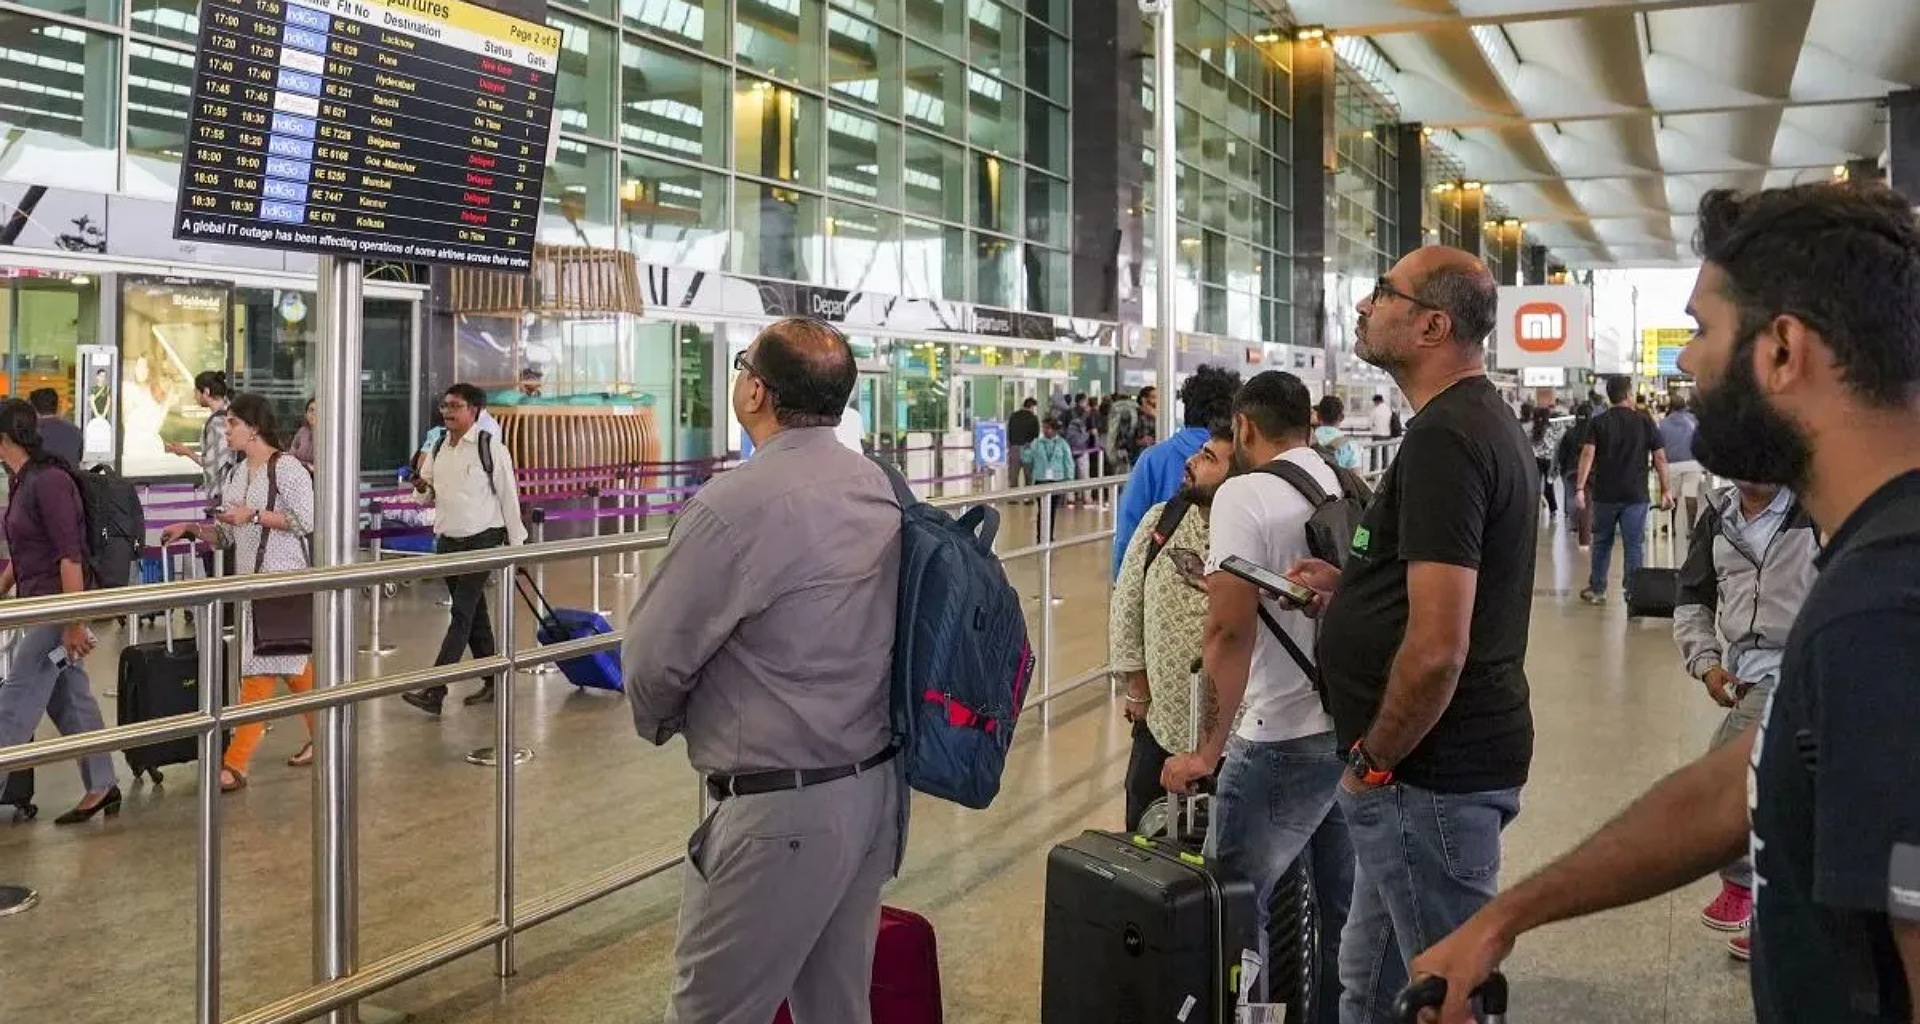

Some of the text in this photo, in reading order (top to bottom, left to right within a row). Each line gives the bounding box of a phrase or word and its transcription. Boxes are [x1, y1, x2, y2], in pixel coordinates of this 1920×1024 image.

[214, 12, 239, 27] 17:00
[379, 53, 397, 66] Pune
[354, 4, 370, 18] No
[384, 11, 441, 38] Destination
[484, 40, 512, 58] Status
[528, 52, 546, 68] Gate
[381, 32, 414, 50] Lucknow
[510, 25, 557, 48] Page 2 of 3
[209, 58, 233, 72] 17:40
[248, 67, 271, 81] 17:40
[373, 94, 399, 108] Ranchi
[475, 117, 484, 126] On
[486, 119, 501, 131] Time
[212, 35, 236, 49] 17:20
[250, 44, 274, 58] 17:20
[376, 74, 416, 92] Hyderabad
[476, 97, 487, 108] On
[489, 100, 503, 112] Time
[203, 104, 228, 118] 17:55
[368, 135, 400, 150] Belgaum
[469, 154, 495, 168] Delayed
[206, 80, 231, 94] 17:45
[245, 89, 268, 102] 17:45
[370, 114, 392, 127] Kochi
[472, 136, 482, 146] On
[483, 137, 498, 149] Time
[197, 150, 222, 162] 18:00
[236, 156, 260, 168] 19:00
[362, 175, 392, 190] Mumbai
[464, 192, 490, 205] Delayed
[365, 155, 381, 166] Goa
[467, 172, 493, 185] Delayed
[192, 195, 216, 208] 18:30
[230, 200, 254, 212] 18:30
[356, 216, 384, 229] Kolkata
[459, 230, 468, 240] On
[470, 232, 485, 242] Time
[194, 172, 218, 185] 18:05
[233, 178, 256, 190] 18:40
[360, 196, 387, 209] Kannur
[461, 209, 486, 225] Delayed
[182, 218, 191, 230] A
[193, 221, 225, 234] global
[227, 224, 239, 234] IT
[240, 226, 273, 240] outage
[275, 229, 292, 241] has
[294, 230, 317, 244] been
[320, 235, 357, 250] affecting
[360, 240, 403, 254] operations
[405, 244, 414, 254] of
[415, 247, 436, 257] some
[438, 248, 466, 260] airlines
[467, 252, 491, 263] across
[493, 254, 509, 265] their
[981, 434, 1000, 462] 6
